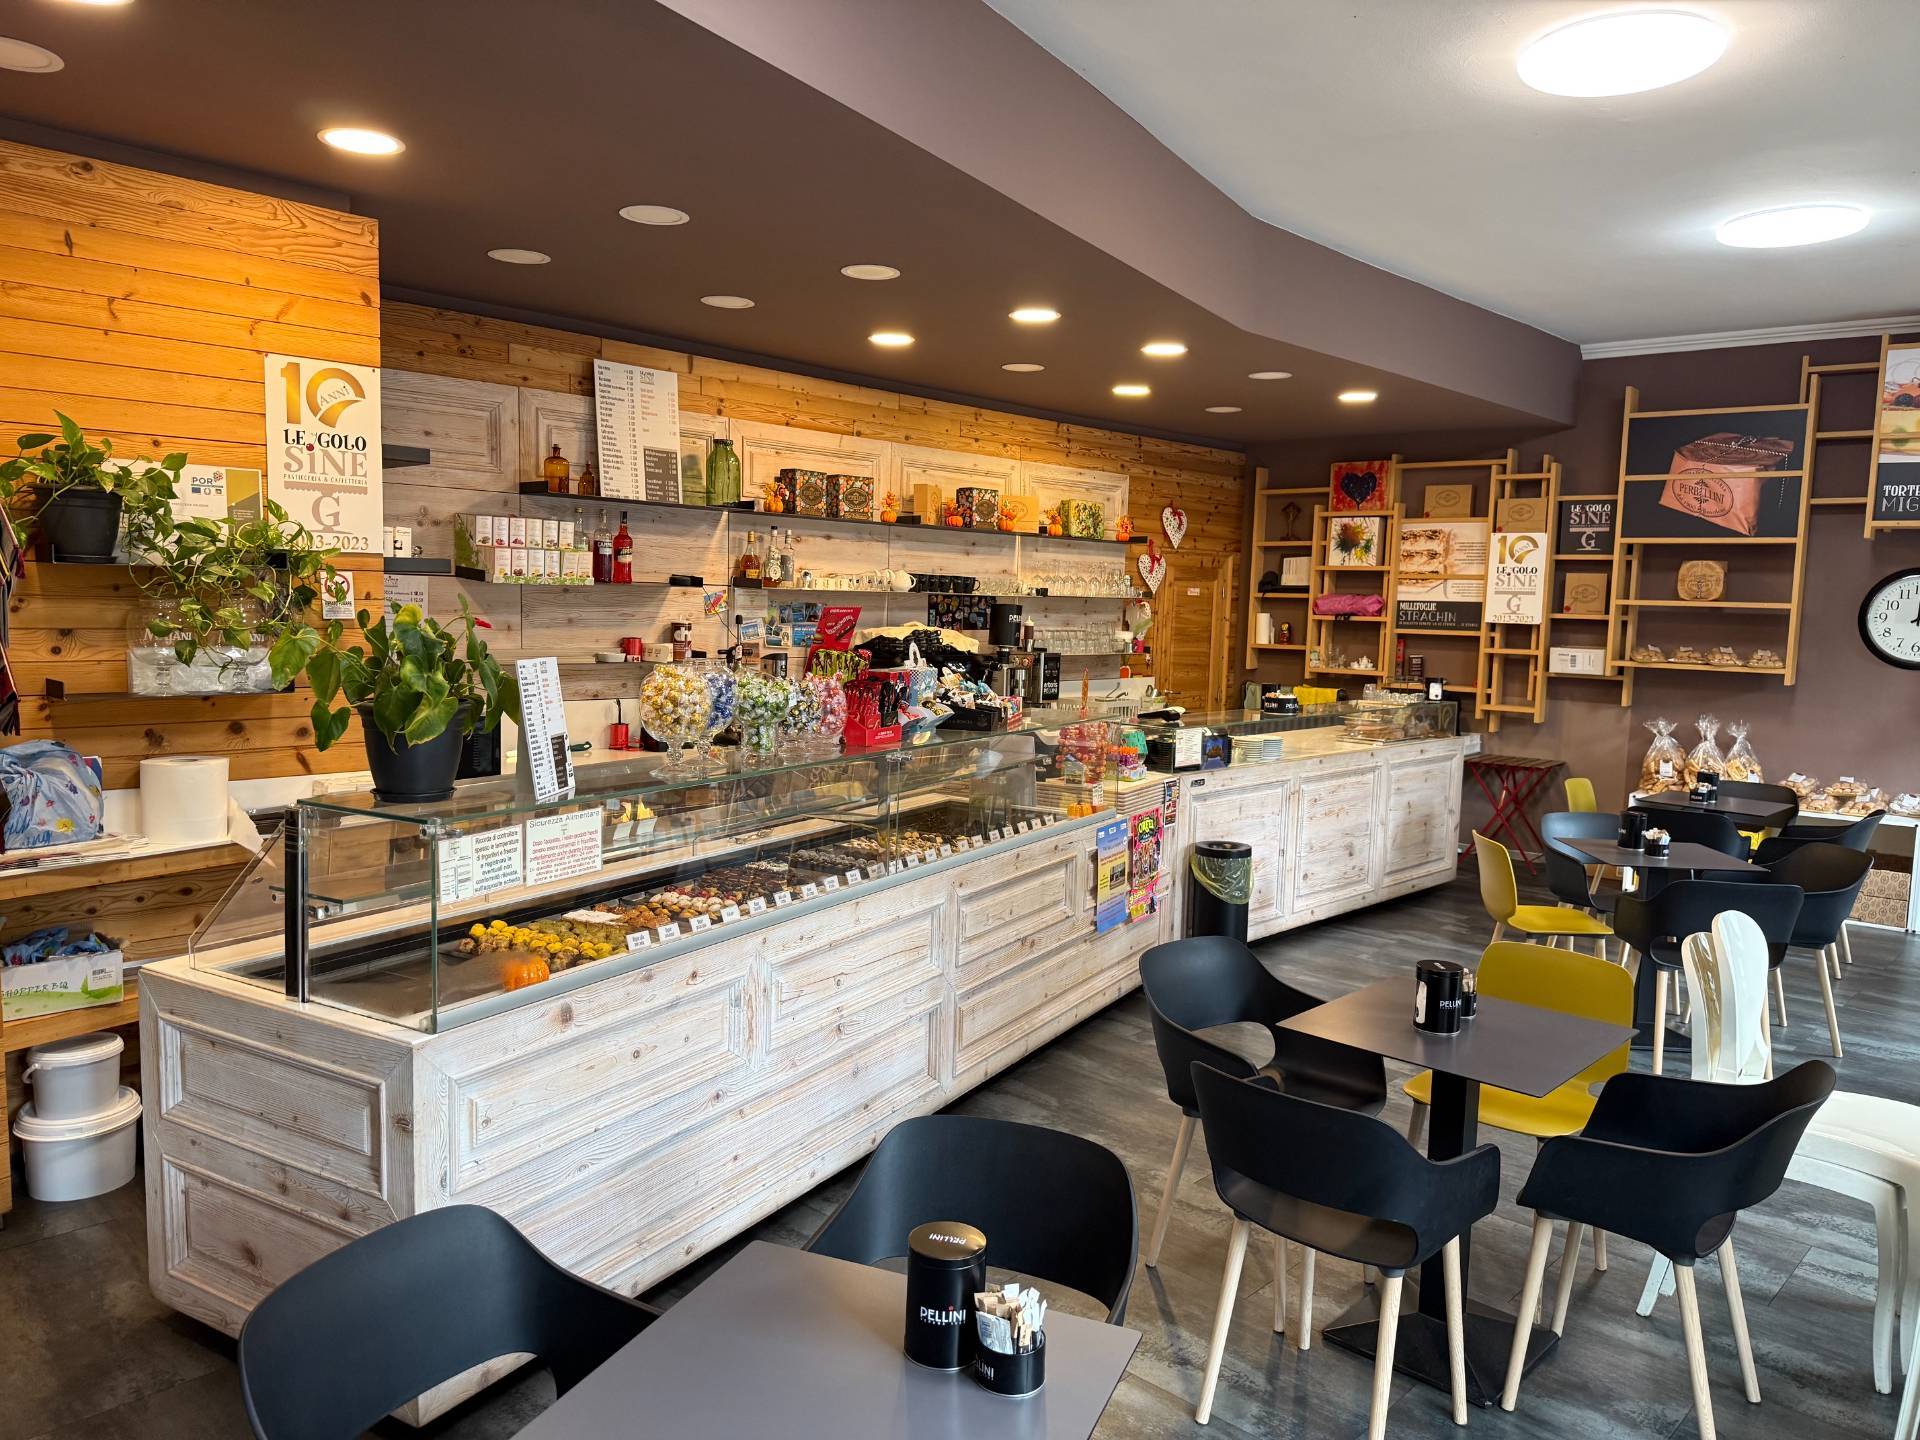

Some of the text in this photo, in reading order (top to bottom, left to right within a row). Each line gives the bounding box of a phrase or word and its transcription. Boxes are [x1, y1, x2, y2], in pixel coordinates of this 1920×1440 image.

[281, 362, 366, 428] 10
[284, 429, 367, 451] LE GOLO
[1679, 483, 1724, 504] PERBLLINI
[1900, 590, 1911, 599] 11
[1886, 600, 1899, 610] 10
[1400, 611, 1456, 622] STRACHIN
[1879, 612, 1887, 622] 9
[1883, 628, 1891, 637] 8
[1896, 638, 1904, 648] 7
[1911, 642, 1920, 653] 6
[929, 1233, 966, 1244] PELLINI
[920, 1306, 966, 1322] PELLINI
